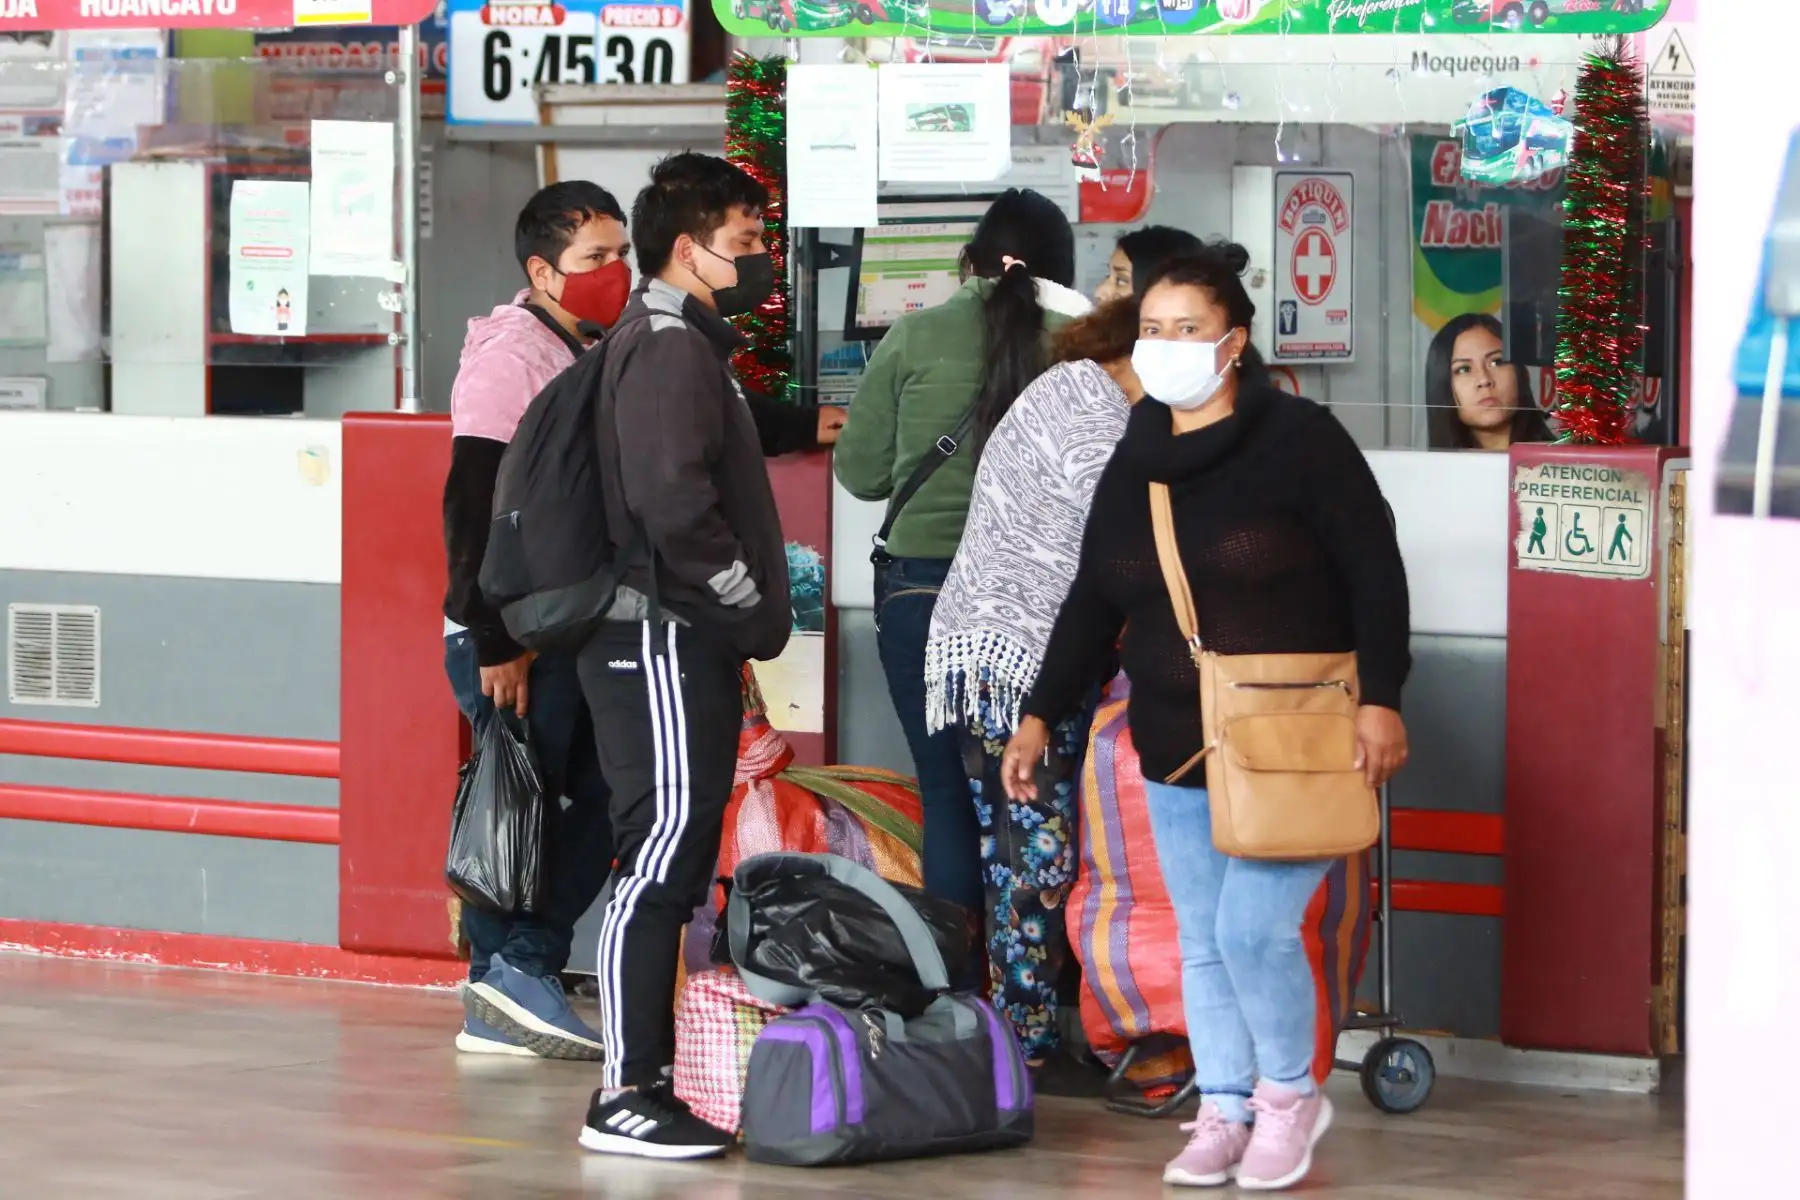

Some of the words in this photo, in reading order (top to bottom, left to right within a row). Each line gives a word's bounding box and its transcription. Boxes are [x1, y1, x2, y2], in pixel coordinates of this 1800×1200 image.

[490, 5, 555, 25] HORA
[604, 6, 659, 27] PRECIO
[483, 29, 596, 101] 6:45
[605, 35, 673, 84] 30
[1411, 51, 1520, 78] Moquegua
[1284, 181, 1345, 225] BOTIQUIN
[1420, 200, 1502, 248] Naci
[1539, 465, 1623, 483] ATENCION
[1518, 482, 1642, 503] PREFERENCIAL
[608, 660, 638, 669] adidas
